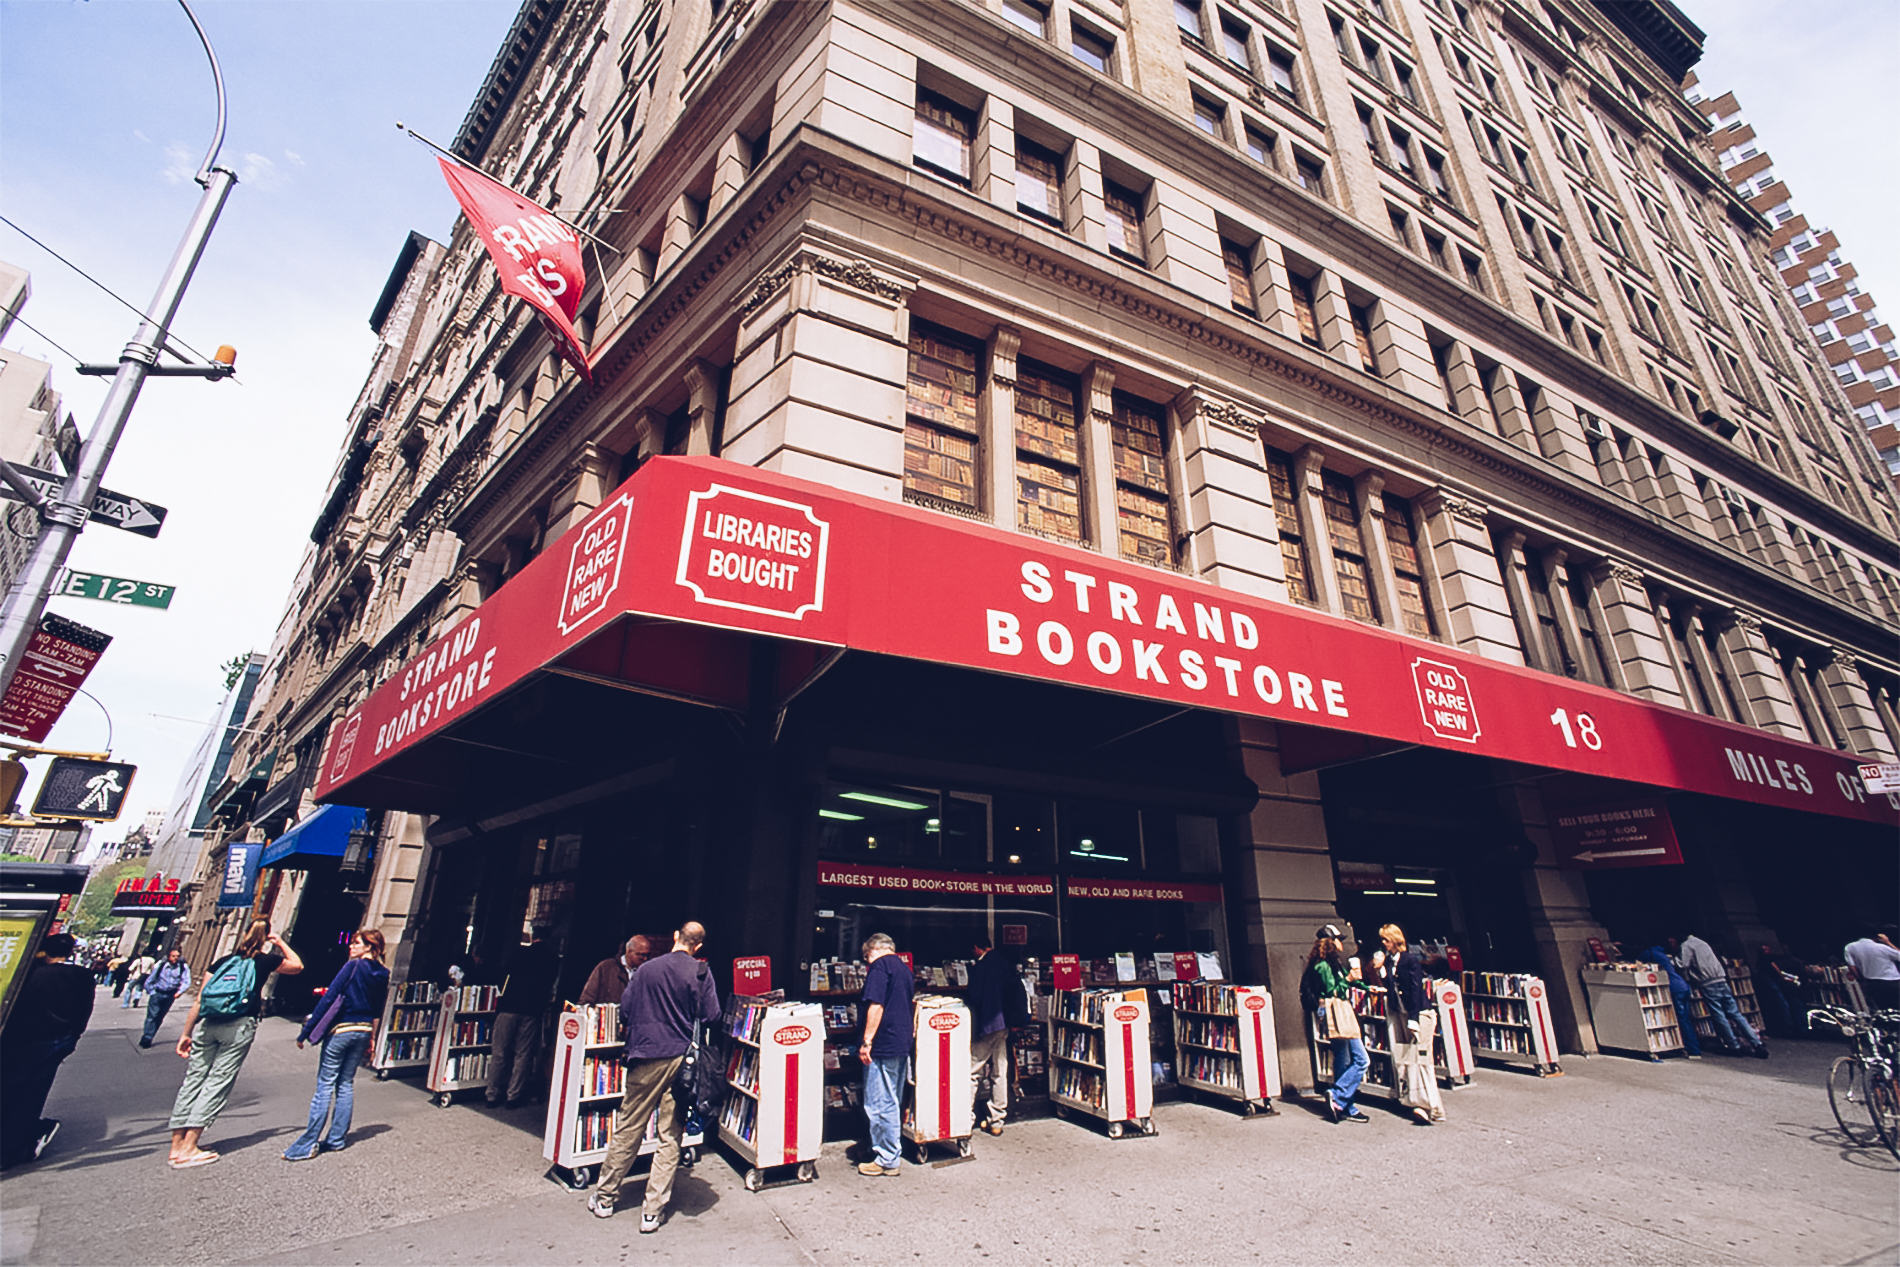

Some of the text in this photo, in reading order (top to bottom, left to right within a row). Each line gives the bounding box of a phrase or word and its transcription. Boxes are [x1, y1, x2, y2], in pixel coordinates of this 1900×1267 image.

[93, 497, 141, 521] WAY
[583, 515, 617, 556] OLD
[702, 510, 812, 559] LIBRARIES
[572, 539, 618, 590] RARE
[707, 548, 799, 592] BOUGHT
[65, 573, 168, 603] E 12 ST
[569, 572, 608, 616] NEW
[1020, 560, 1259, 650] STRAND
[35, 633, 97, 661] NO STANDING
[400, 617, 481, 702] STRAND
[986, 608, 1350, 718] BOOKSTORE
[23, 679, 69, 699] STANDING
[1427, 670, 1457, 690] OLD
[374, 646, 497, 756] BOOKSTORE
[1425, 688, 1468, 712] RARE
[1434, 709, 1468, 731] NEW
[1550, 707, 1602, 750] 18
[1724, 747, 1814, 795] MILES
[1836, 771, 1866, 804] OF
[1861, 767, 1879, 778] NO
[1601, 810, 1631, 822] BOOKS
[223, 847, 247, 894] mavi
[821, 872, 875, 886] LARGEST
[879, 876, 909, 888] USED
[982, 883, 993, 893] IN
[995, 883, 1014, 893] THE
[1017, 884, 1053, 894] WORLD
[1092, 887, 1110, 897] OLD
[1112, 888, 1130, 898] AND
[1132, 889, 1153, 898] RARE
[1156, 890, 1184, 899] BOOKS
[736, 959, 767, 969] SPECIAL
[775, 1030, 810, 1042] STRAND
